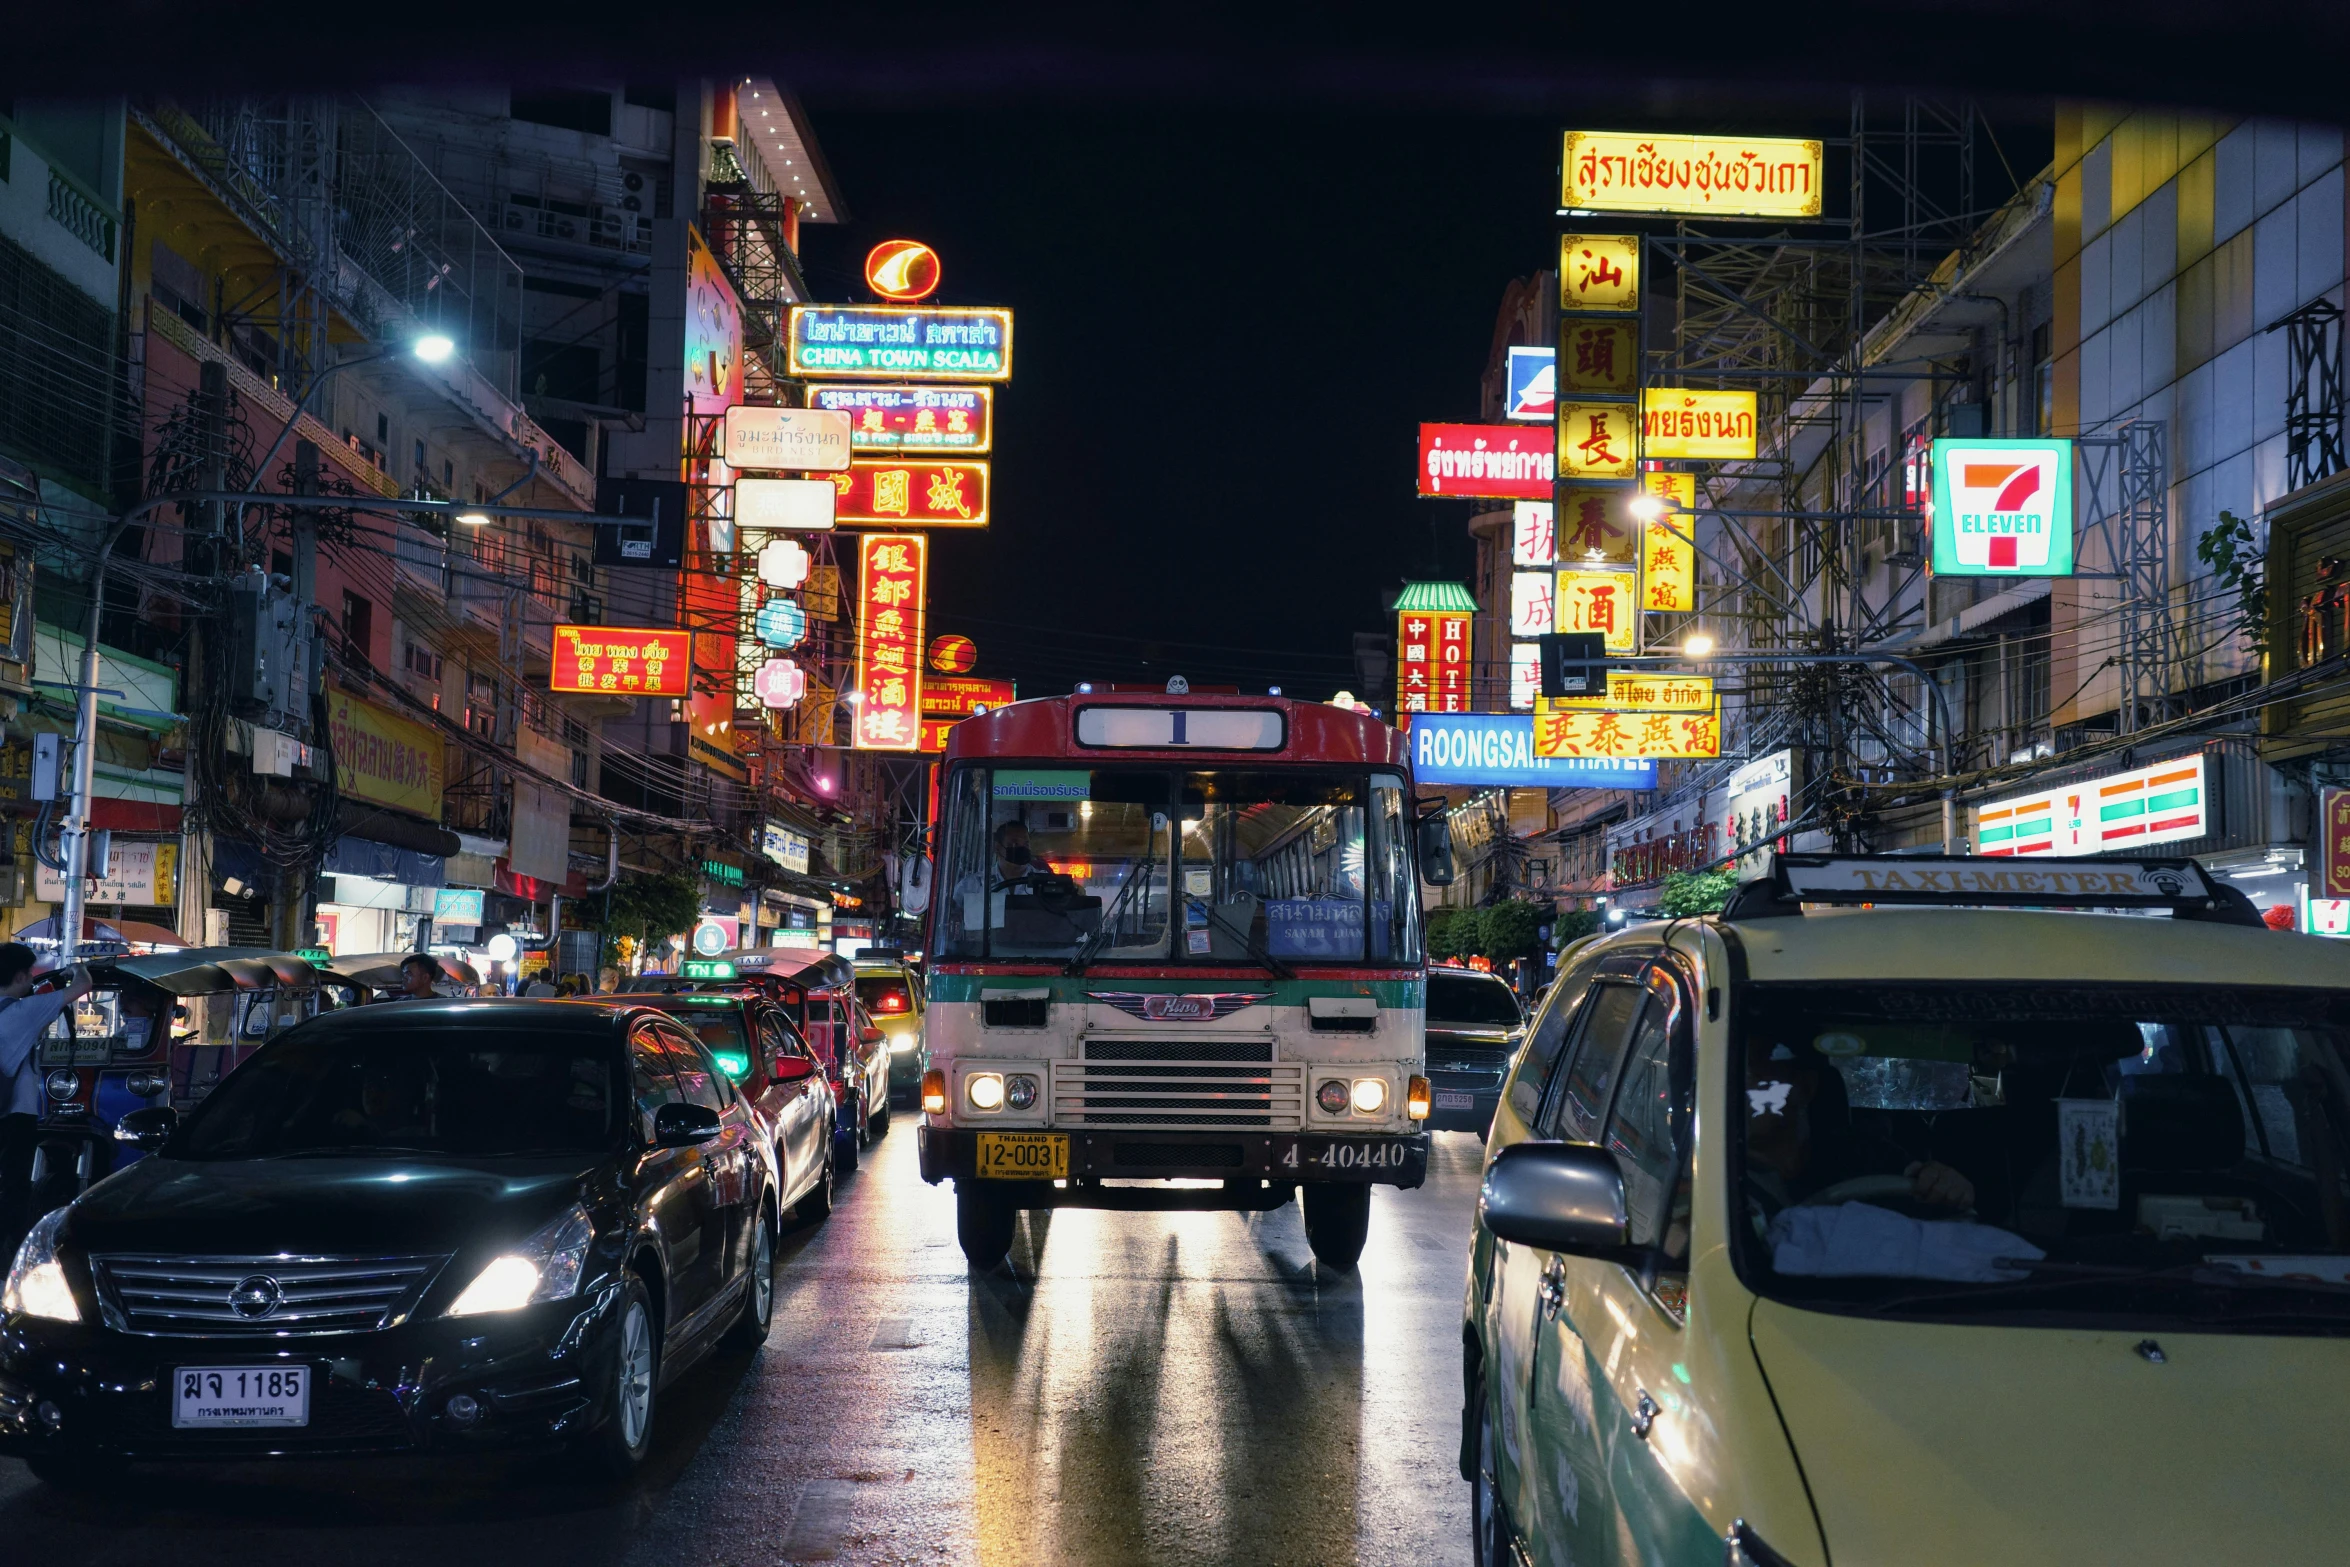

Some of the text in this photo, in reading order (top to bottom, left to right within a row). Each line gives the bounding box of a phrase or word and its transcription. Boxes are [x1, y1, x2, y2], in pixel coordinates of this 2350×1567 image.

[925, 318, 997, 345] สกาล่า
[802, 348, 998, 369] CHINA TOWN SCALA
[1643, 398, 1753, 439] ทยรังนก
[752, 445, 822, 456] BIRD NEST
[1961, 514, 2041, 534] ELEVEN
[864, 543, 916, 743] 銀都魚翅酒樓
[1404, 619, 1428, 736] 中國大酒
[1444, 621, 1462, 712] HOTE
[578, 674, 661, 690] 批发干果
[1168, 711, 1190, 744] 1
[1419, 728, 1550, 768] ROONGSA
[1852, 868, 2142, 894] TAXI-METER
[1284, 928, 1365, 939] SANAM LUAN
[80, 944, 116, 953] TAXI
[1158, 998, 1200, 1016] Hino
[998, 1135, 1047, 1143] THAILAND
[985, 1143, 1059, 1167] 12-0031
[237, 1372, 299, 1398] 1185
